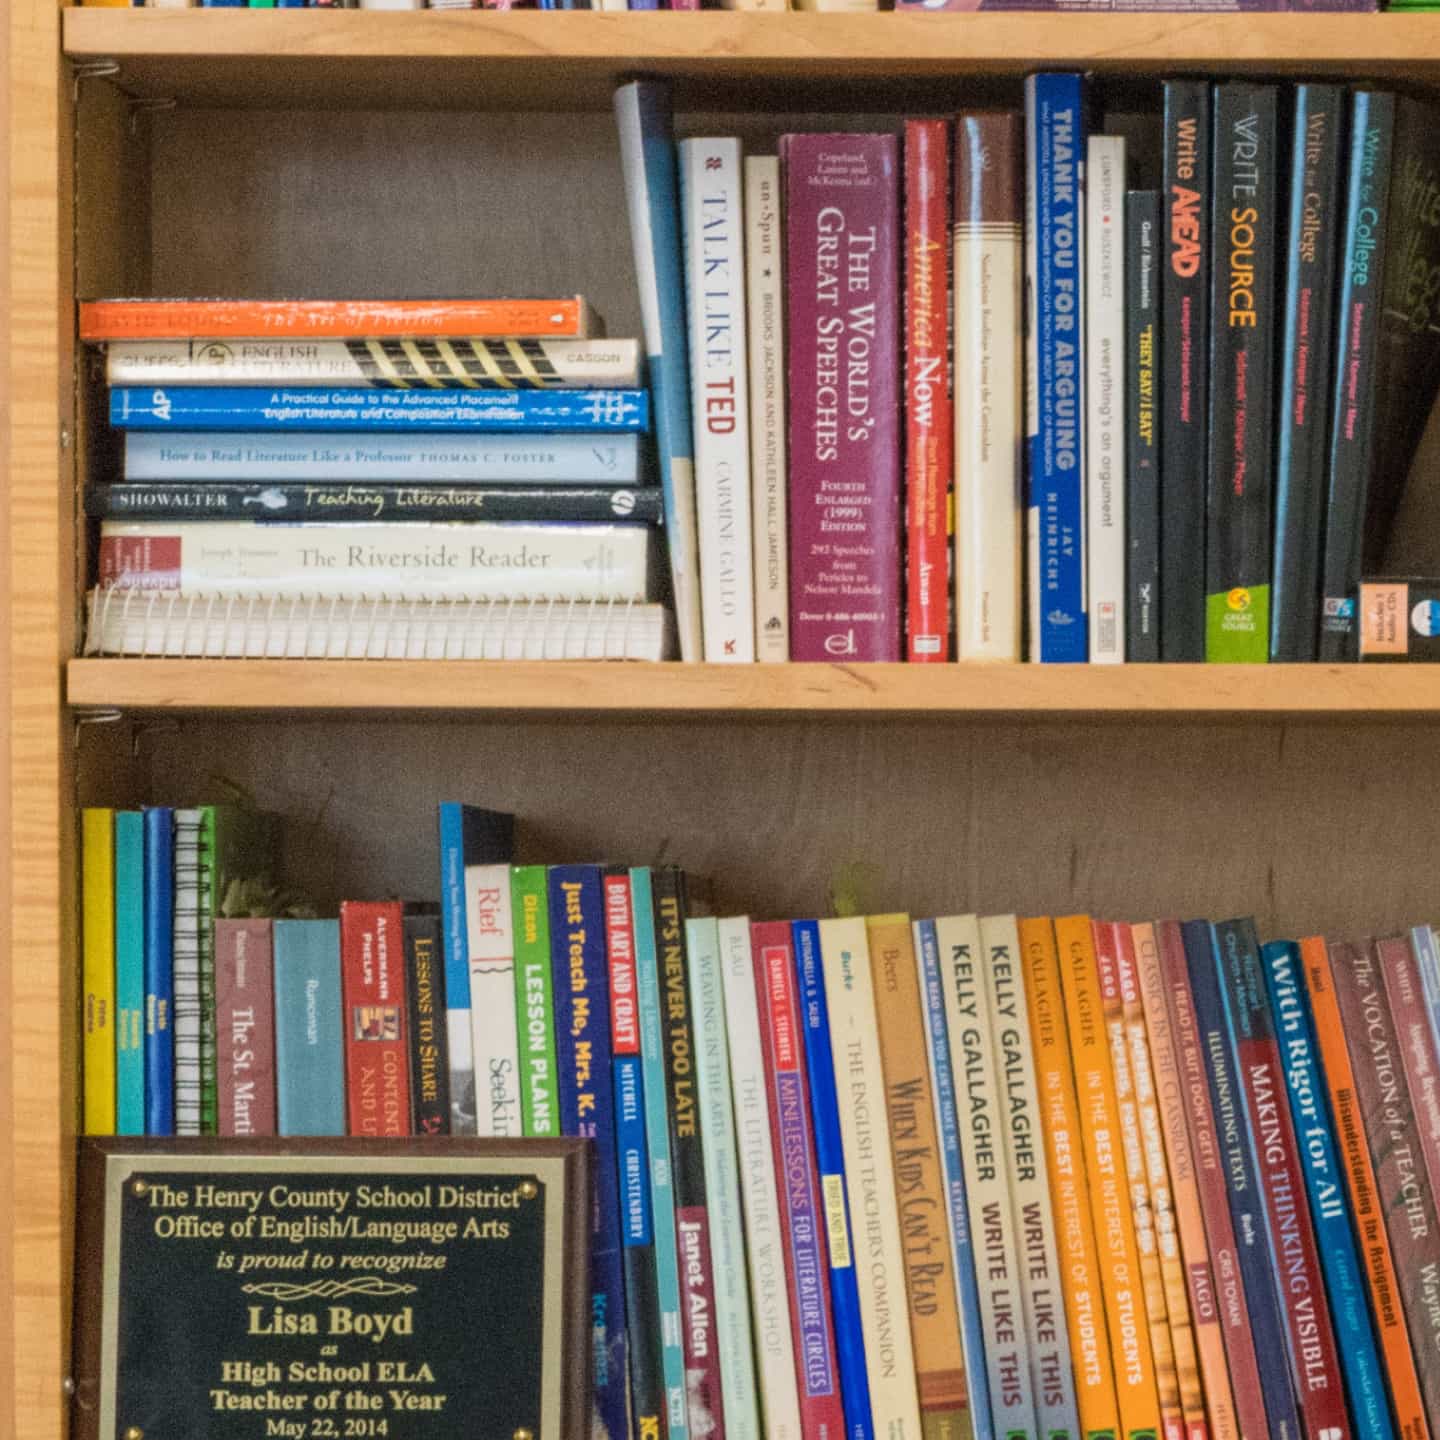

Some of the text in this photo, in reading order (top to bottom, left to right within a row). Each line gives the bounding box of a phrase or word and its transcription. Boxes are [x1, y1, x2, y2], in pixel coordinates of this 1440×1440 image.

[1230, 113, 1258, 328] WRITE SOURCE
[1052, 109, 1075, 471] THANK YOU FOR ARGUING
[701, 189, 737, 435] TALK LIKE TED
[160, 450, 186, 463] How
[191, 451, 205, 463] to
[211, 450, 242, 463] Read
[246, 450, 308, 463] Literature
[312, 450, 339, 463] Like
[343, 454, 351, 463] a
[355, 450, 413, 463] Professor
[420, 453, 477, 463] THOMAS
[502, 453, 555, 463] FOSTER
[305, 489, 483, 516] Teaching Literature
[303, 545, 551, 569] The Riverside Reader
[525, 964, 550, 1134] LESSON PLANS
[1271, 955, 1341, 1218] With Rigor for All
[952, 944, 1024, 1409] KELLY GALLAGHER WRITE LIKE THIS
[148, 1187, 520, 1213] The Henry County School District
[155, 1216, 510, 1243] Office of English/Language Arts
[1250, 1062, 1331, 1393] MAKING THINKING VISIBLE
[217, 1251, 447, 1274] is proud to recognize
[248, 1307, 413, 1341] Lisa Boyd
[321, 1344, 338, 1355] as
[222, 1362, 435, 1386] High School ELA
[211, 1390, 446, 1411] Teacher of the Year
[266, 1420, 388, 1439] May 22, 2014
